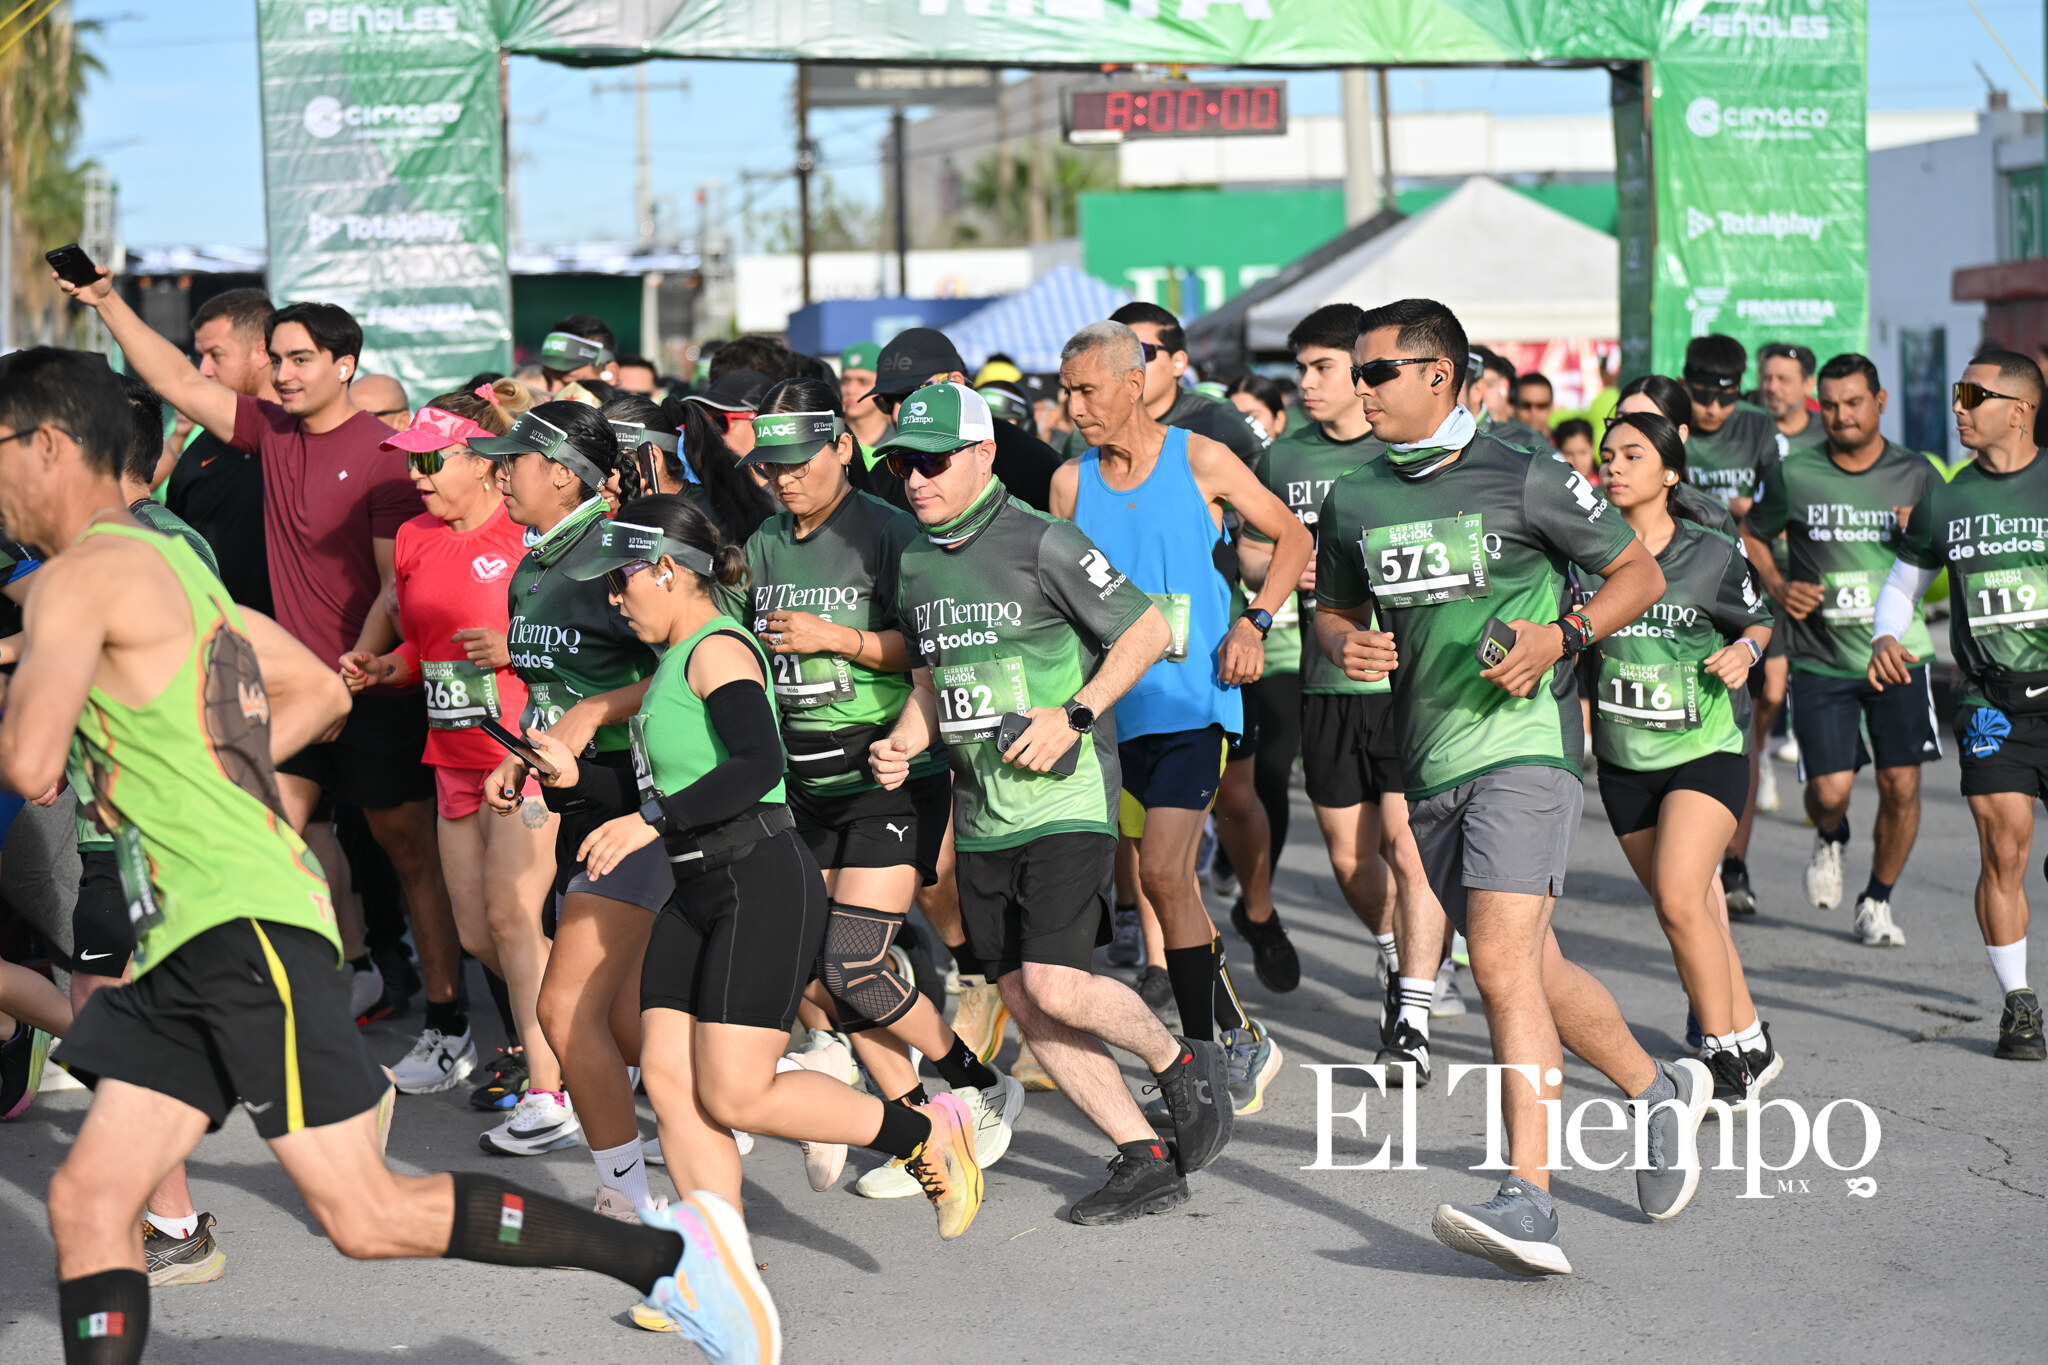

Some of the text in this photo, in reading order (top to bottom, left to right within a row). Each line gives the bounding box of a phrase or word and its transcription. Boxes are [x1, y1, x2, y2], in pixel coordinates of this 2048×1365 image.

[344, 102, 464, 126] cimaco
[1723, 106, 1828, 127] cimaco
[1717, 210, 1822, 241] Totalplay
[1736, 298, 1836, 318] FRONTERA
[908, 415, 933, 425] Tiempo
[1287, 480, 1313, 507] El
[1390, 522, 1433, 533] CARRERA
[1465, 520, 1480, 528] 573
[1807, 503, 1898, 530] El Tiemp
[1947, 517, 1971, 543] El
[1808, 527, 1832, 541] de
[1468, 532, 1486, 587] MEDALLA
[1948, 537, 2046, 560] de todos
[1381, 542, 1450, 583] 573
[755, 584, 858, 611] El Tiempo
[1836, 586, 1871, 608] 68
[1978, 585, 2036, 615] 119
[914, 598, 1022, 634] El Tiempo
[509, 615, 581, 654] Tiempo
[937, 629, 998, 650] todos
[1175, 609, 1185, 655] MEDALLA
[774, 654, 802, 684] 21
[944, 666, 974, 674] CARRERA
[1006, 662, 1020, 670] 182
[424, 680, 470, 709] 268
[483, 674, 499, 718] MEDALLA
[940, 685, 995, 720] 182
[1011, 675, 1026, 716] EDALLA
[1611, 678, 1672, 711] 116
[1687, 677, 1697, 722] MEDALLA
